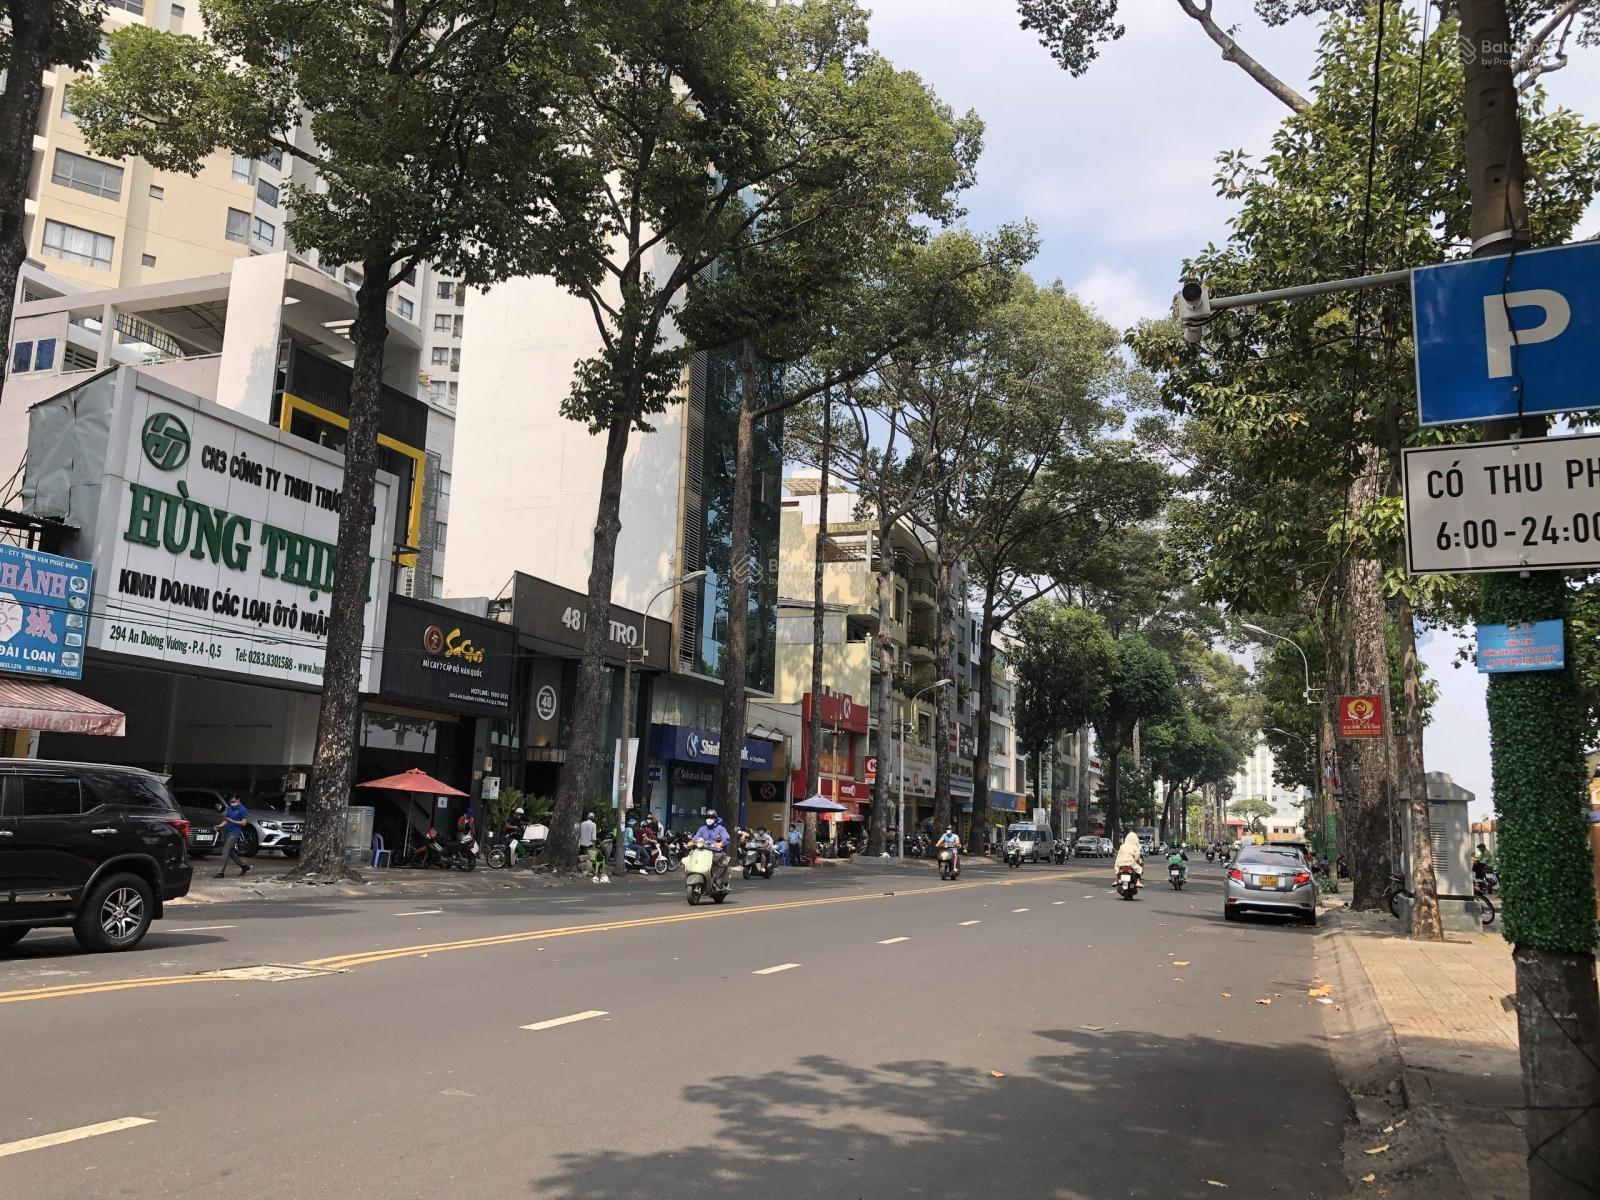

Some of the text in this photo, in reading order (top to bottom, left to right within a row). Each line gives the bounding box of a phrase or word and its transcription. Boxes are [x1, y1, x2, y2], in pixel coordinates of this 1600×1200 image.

[1483, 289, 1571, 379] P
[202, 445, 228, 474] CN3
[230, 452, 263, 486] CÔNG
[265, 467, 281, 491] TY
[284, 474, 313, 503] TNHH
[1427, 458, 1600, 499] CÓ THU PH
[124, 480, 252, 571] HÙNG
[0, 560, 68, 599] HÀNH
[118, 569, 157, 599] KINH
[160, 578, 210, 611] DOANH
[212, 588, 240, 617] CÁC
[242, 597, 271, 627] LOẠI
[273, 600, 298, 629] ÔTÔ
[110, 625, 126, 641] 294
[128, 629, 139, 644] An
[141, 630, 164, 650] Dương
[166, 635, 188, 654] Vương
[193, 640, 204, 655] P.4
[209, 643, 222, 659] Q.5
[235, 648, 247, 662] Tel:
[562, 607, 637, 646] 48 TRO
[0, 643, 56, 663] ĐÀI LOAN
[541, 696, 552, 708] 48
